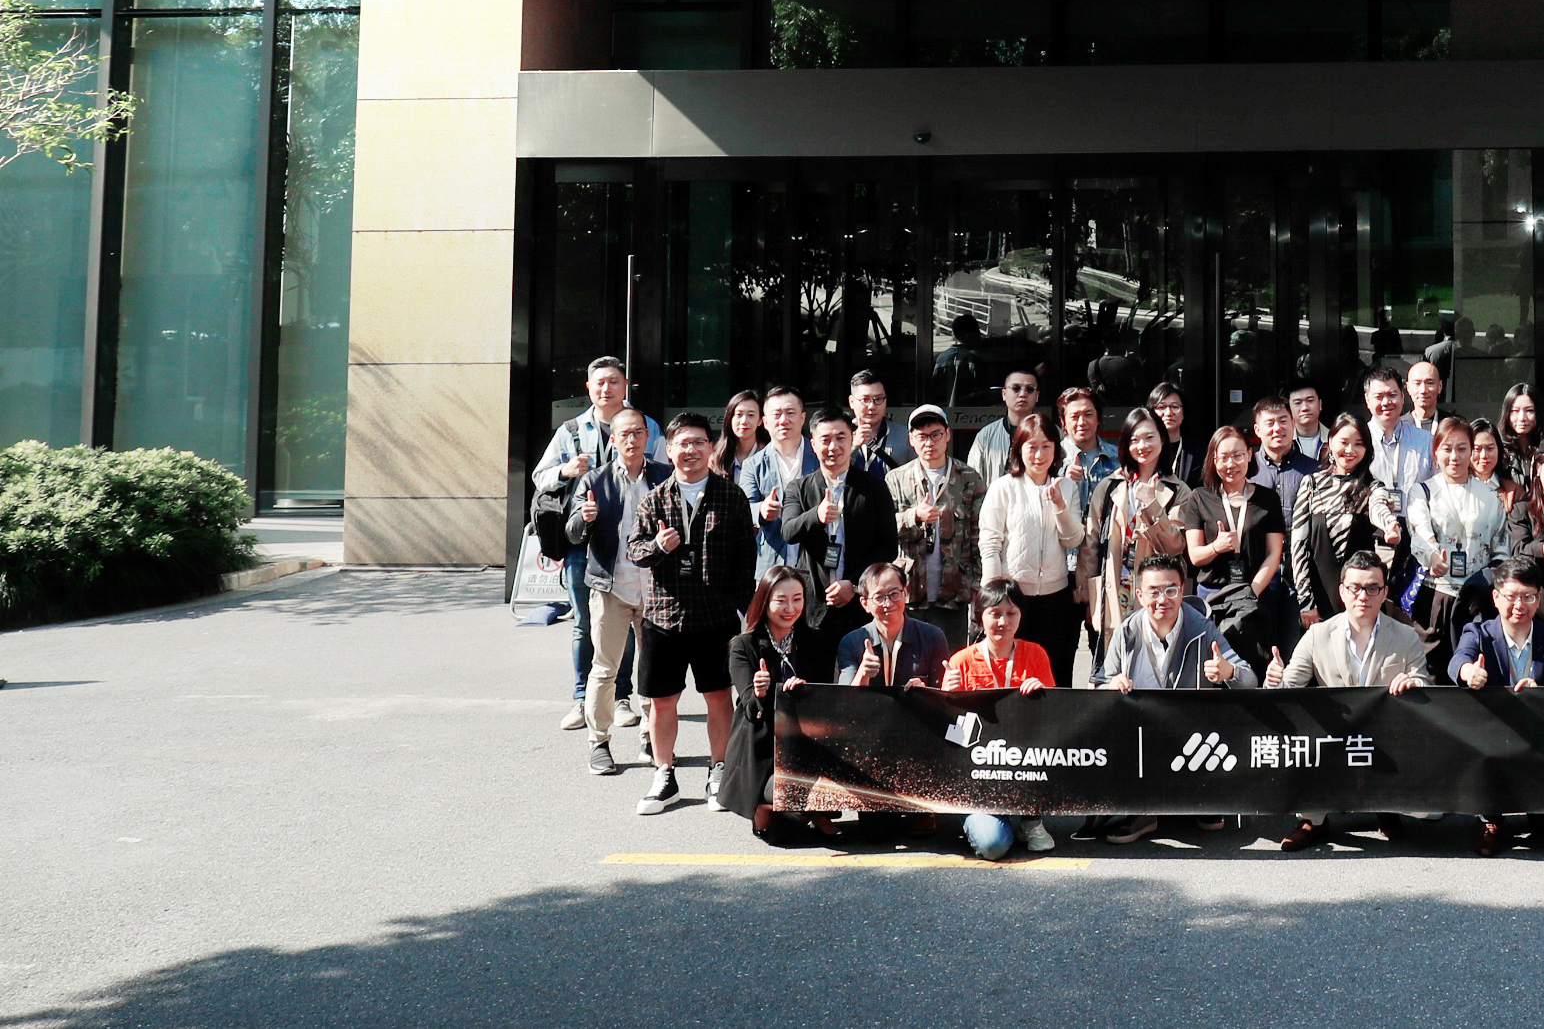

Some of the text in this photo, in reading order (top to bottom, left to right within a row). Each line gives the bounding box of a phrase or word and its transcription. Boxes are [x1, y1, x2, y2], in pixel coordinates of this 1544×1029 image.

[526, 587, 535, 595] NO
[1250, 734, 1375, 769] 腾讯广告
[970, 769, 1049, 782] GREATER CHINA
